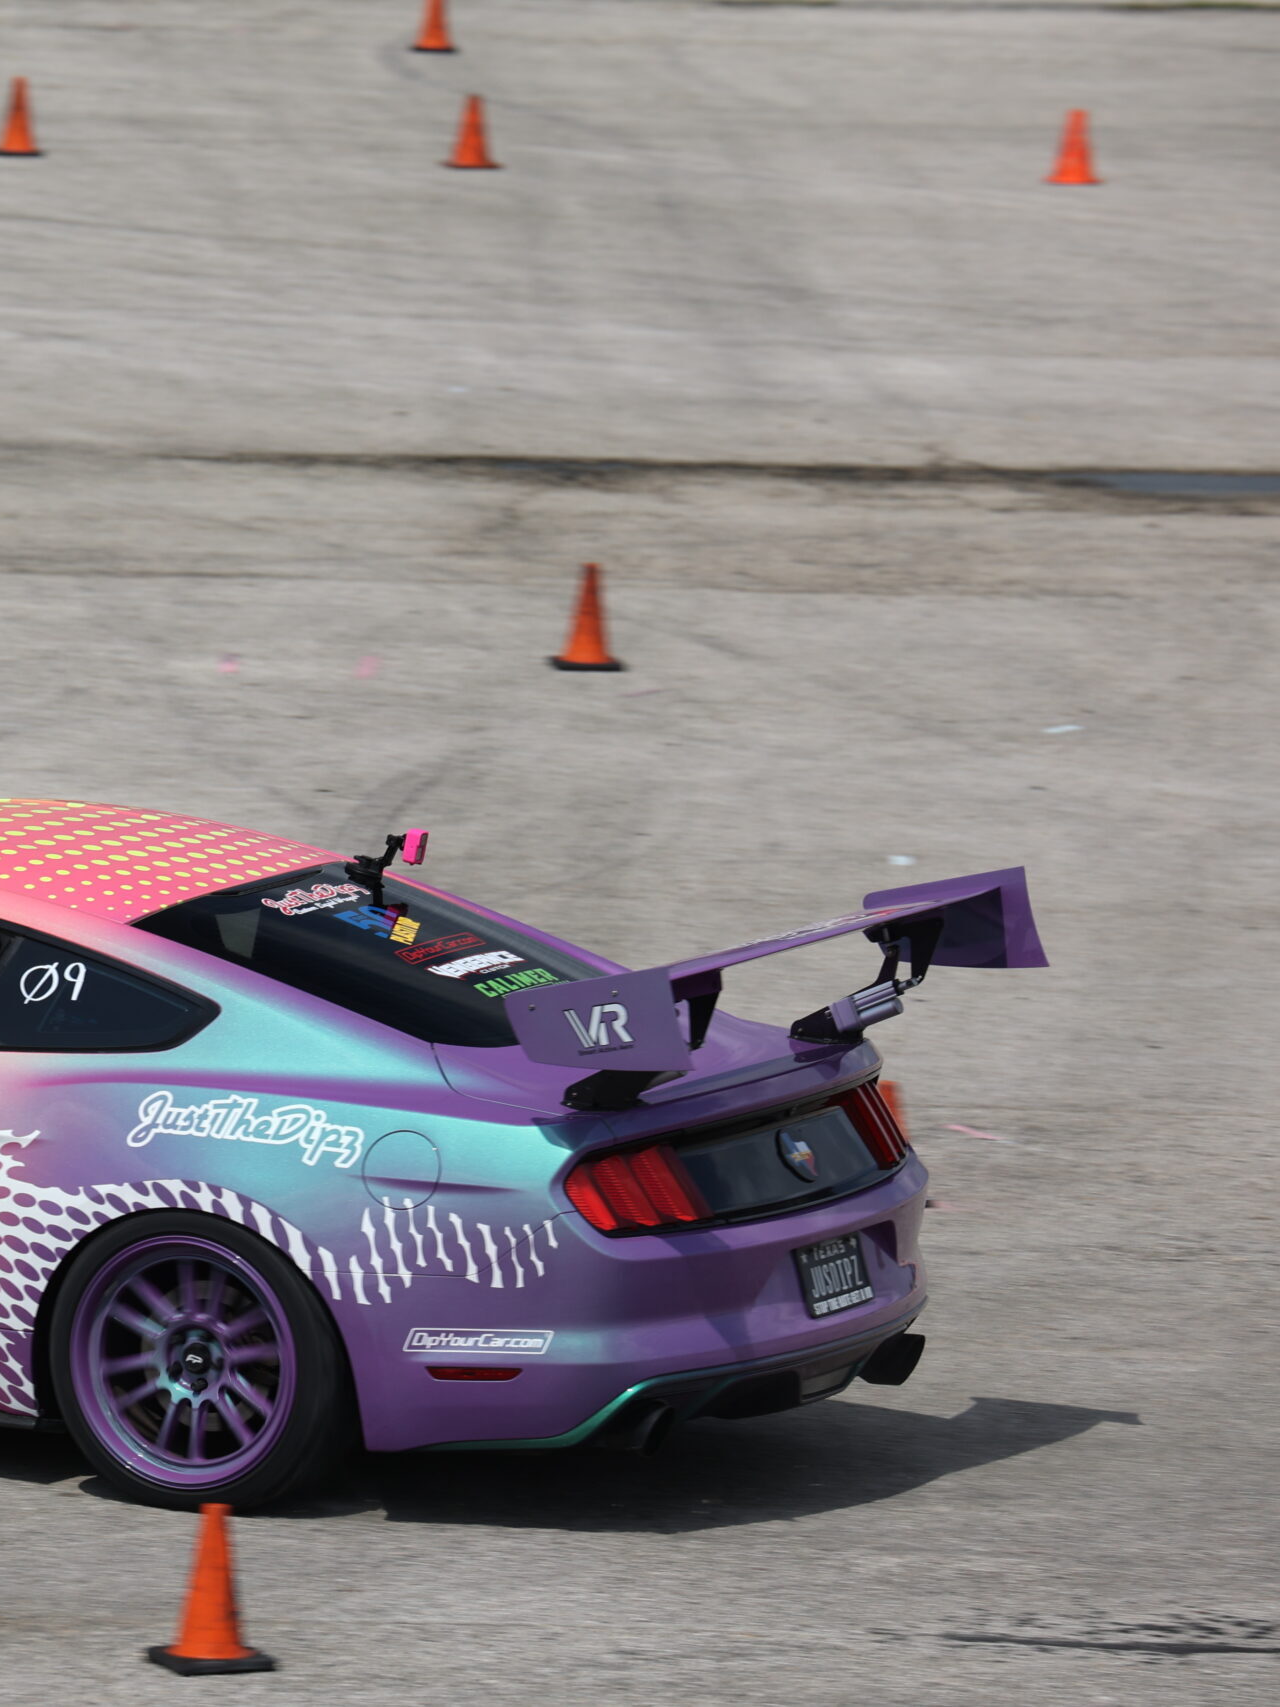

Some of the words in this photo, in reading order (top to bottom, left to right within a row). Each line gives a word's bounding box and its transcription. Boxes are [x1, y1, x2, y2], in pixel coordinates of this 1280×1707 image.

[473, 967, 560, 998] CALIMER
[126, 1090, 365, 1169] JustTheDipz
[813, 1239, 846, 1260] TEXAS
[410, 1332, 545, 1349] DipYourCar.com
